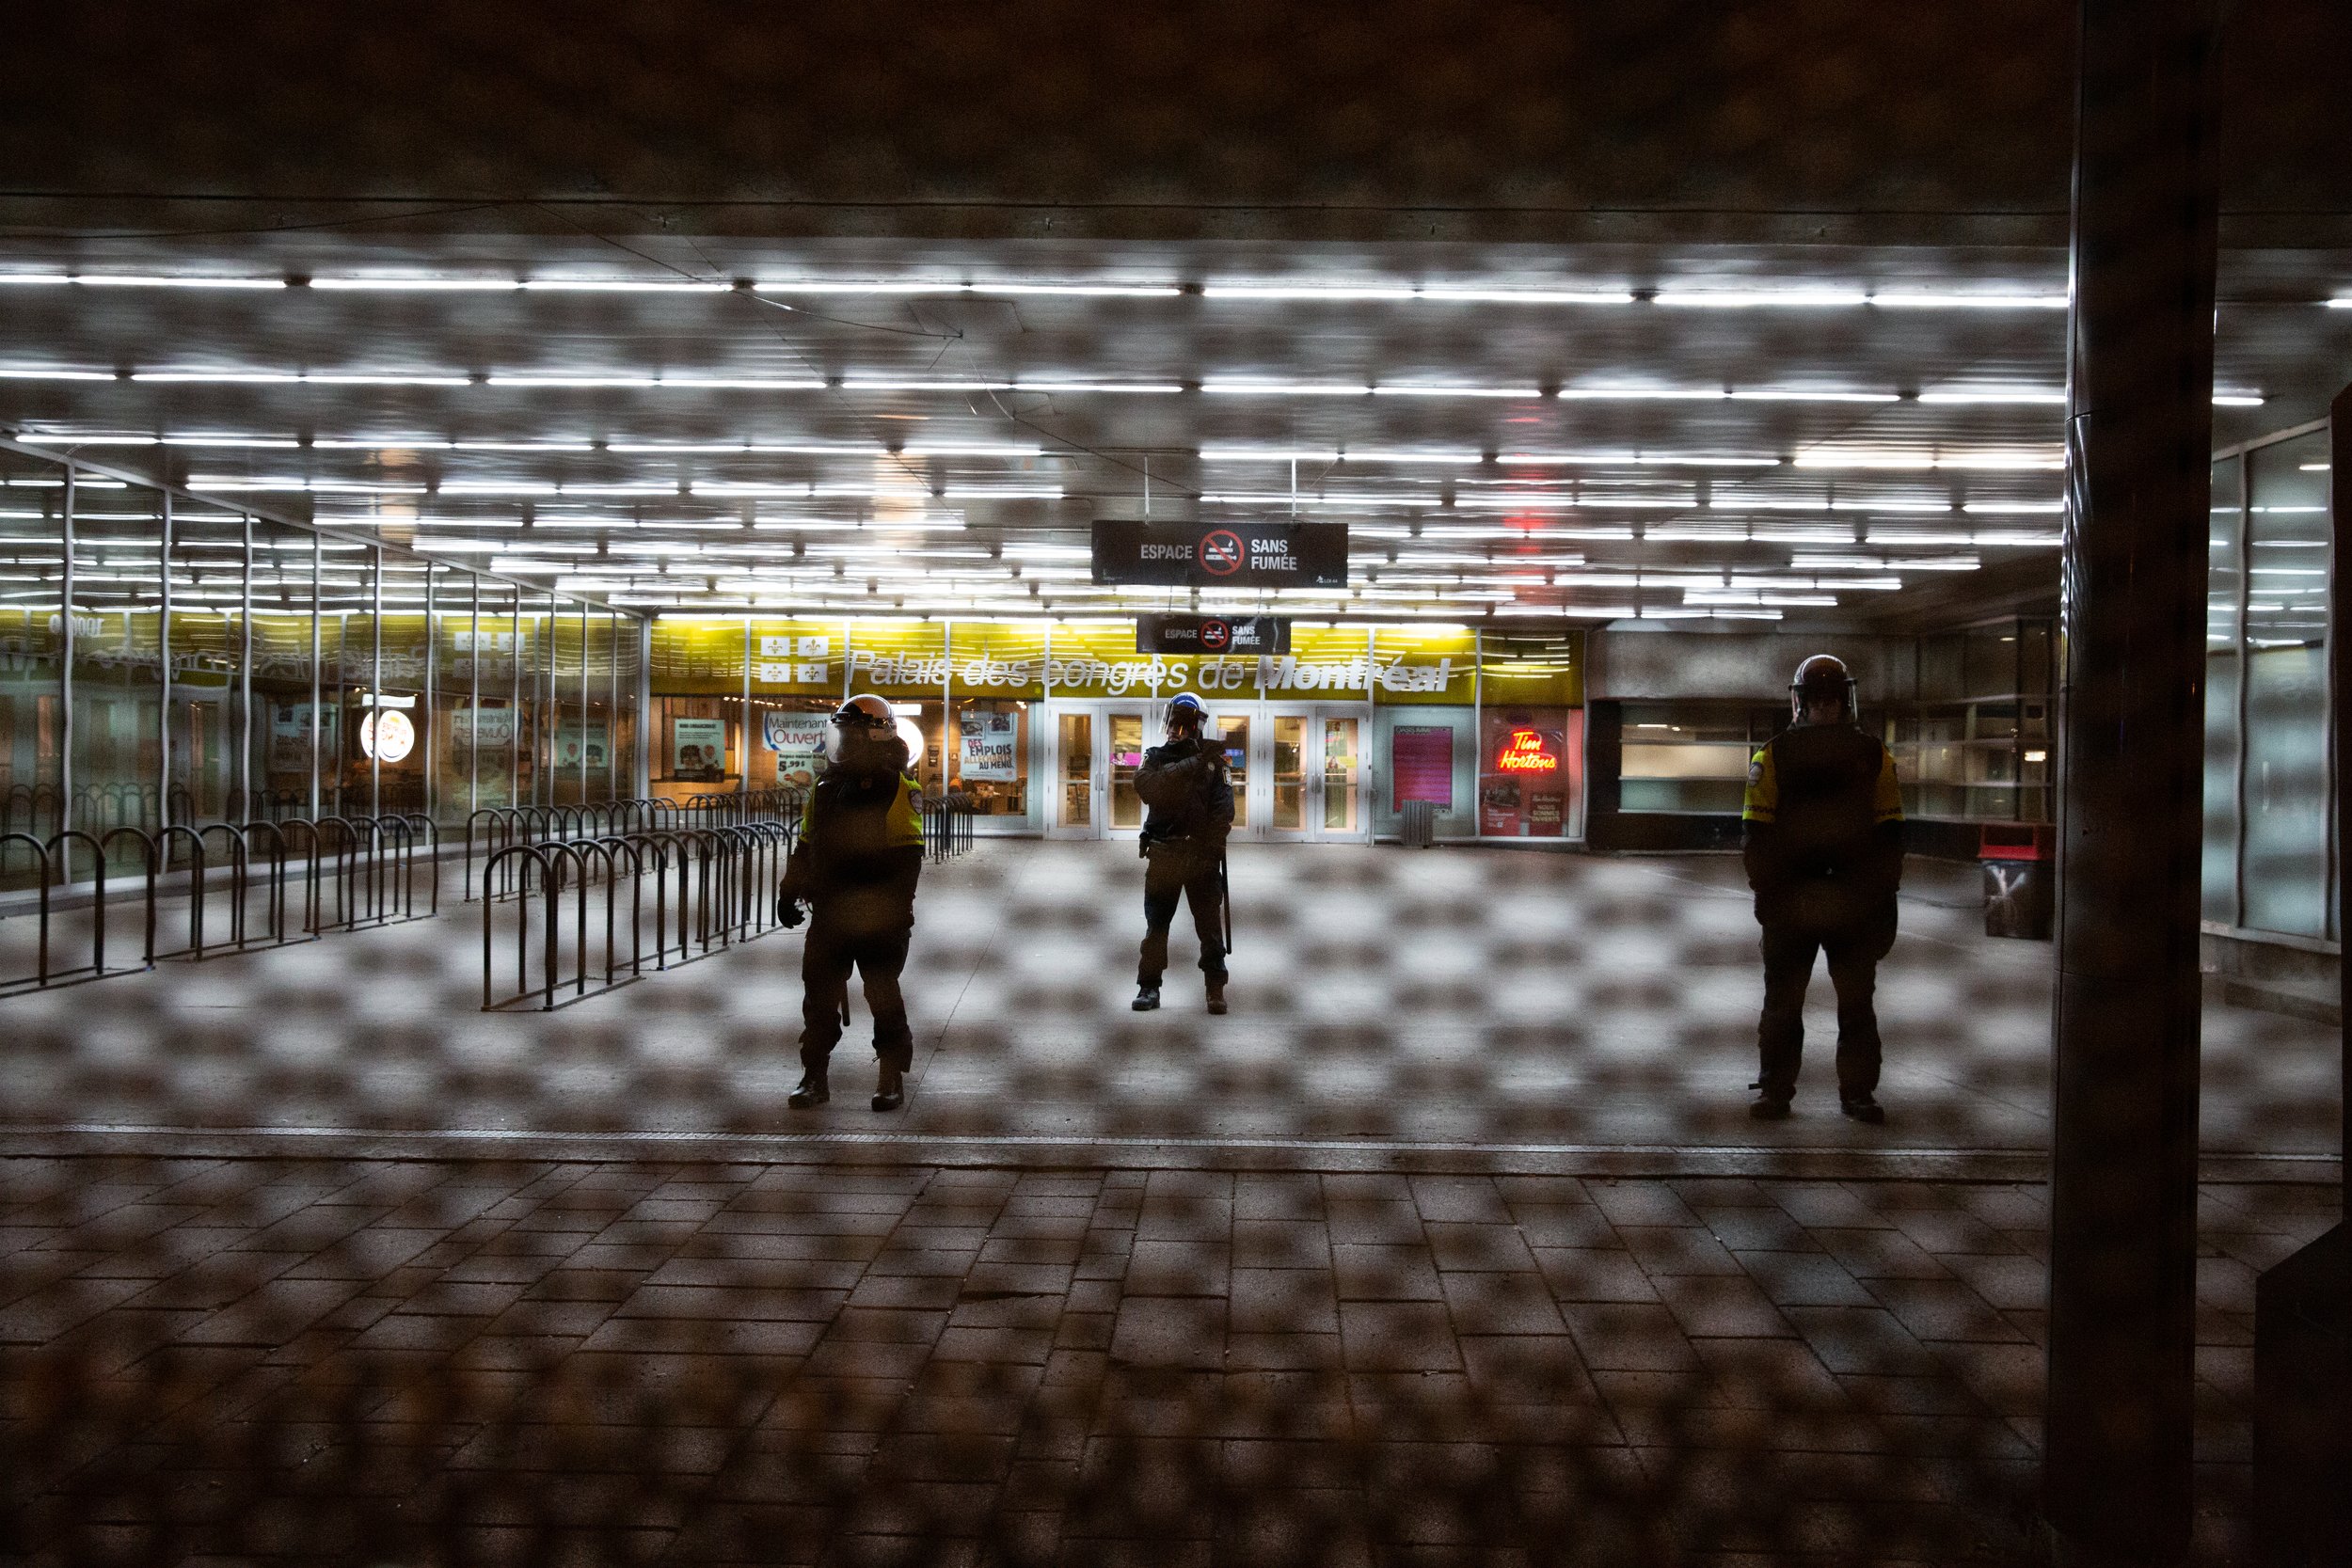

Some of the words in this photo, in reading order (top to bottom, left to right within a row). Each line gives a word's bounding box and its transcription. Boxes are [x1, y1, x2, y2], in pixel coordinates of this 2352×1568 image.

[1140, 544, 1193, 560] ESPACE
[1250, 539, 1288, 553] SANS
[1250, 554, 1297, 570] FUMÉE
[1165, 628, 1197, 639] ESPACE
[1232, 626, 1255, 635] SANS
[1232, 635, 1261, 645] FUMÉE
[848, 650, 950, 686] Palais
[962, 651, 1029, 688] des
[1041, 657, 1188, 696] congrès
[1198, 654, 1245, 690] de
[1254, 654, 1452, 692] Montréal
[769, 718, 827, 729] Maintenant
[773, 729, 826, 745] Ouvert
[968, 739, 983, 748] DES
[1513, 731, 1542, 751] Tim
[970, 744, 1012, 756] EMPLOIS
[1500, 750, 1556, 768] Hortons
[979, 762, 990, 770] AU
